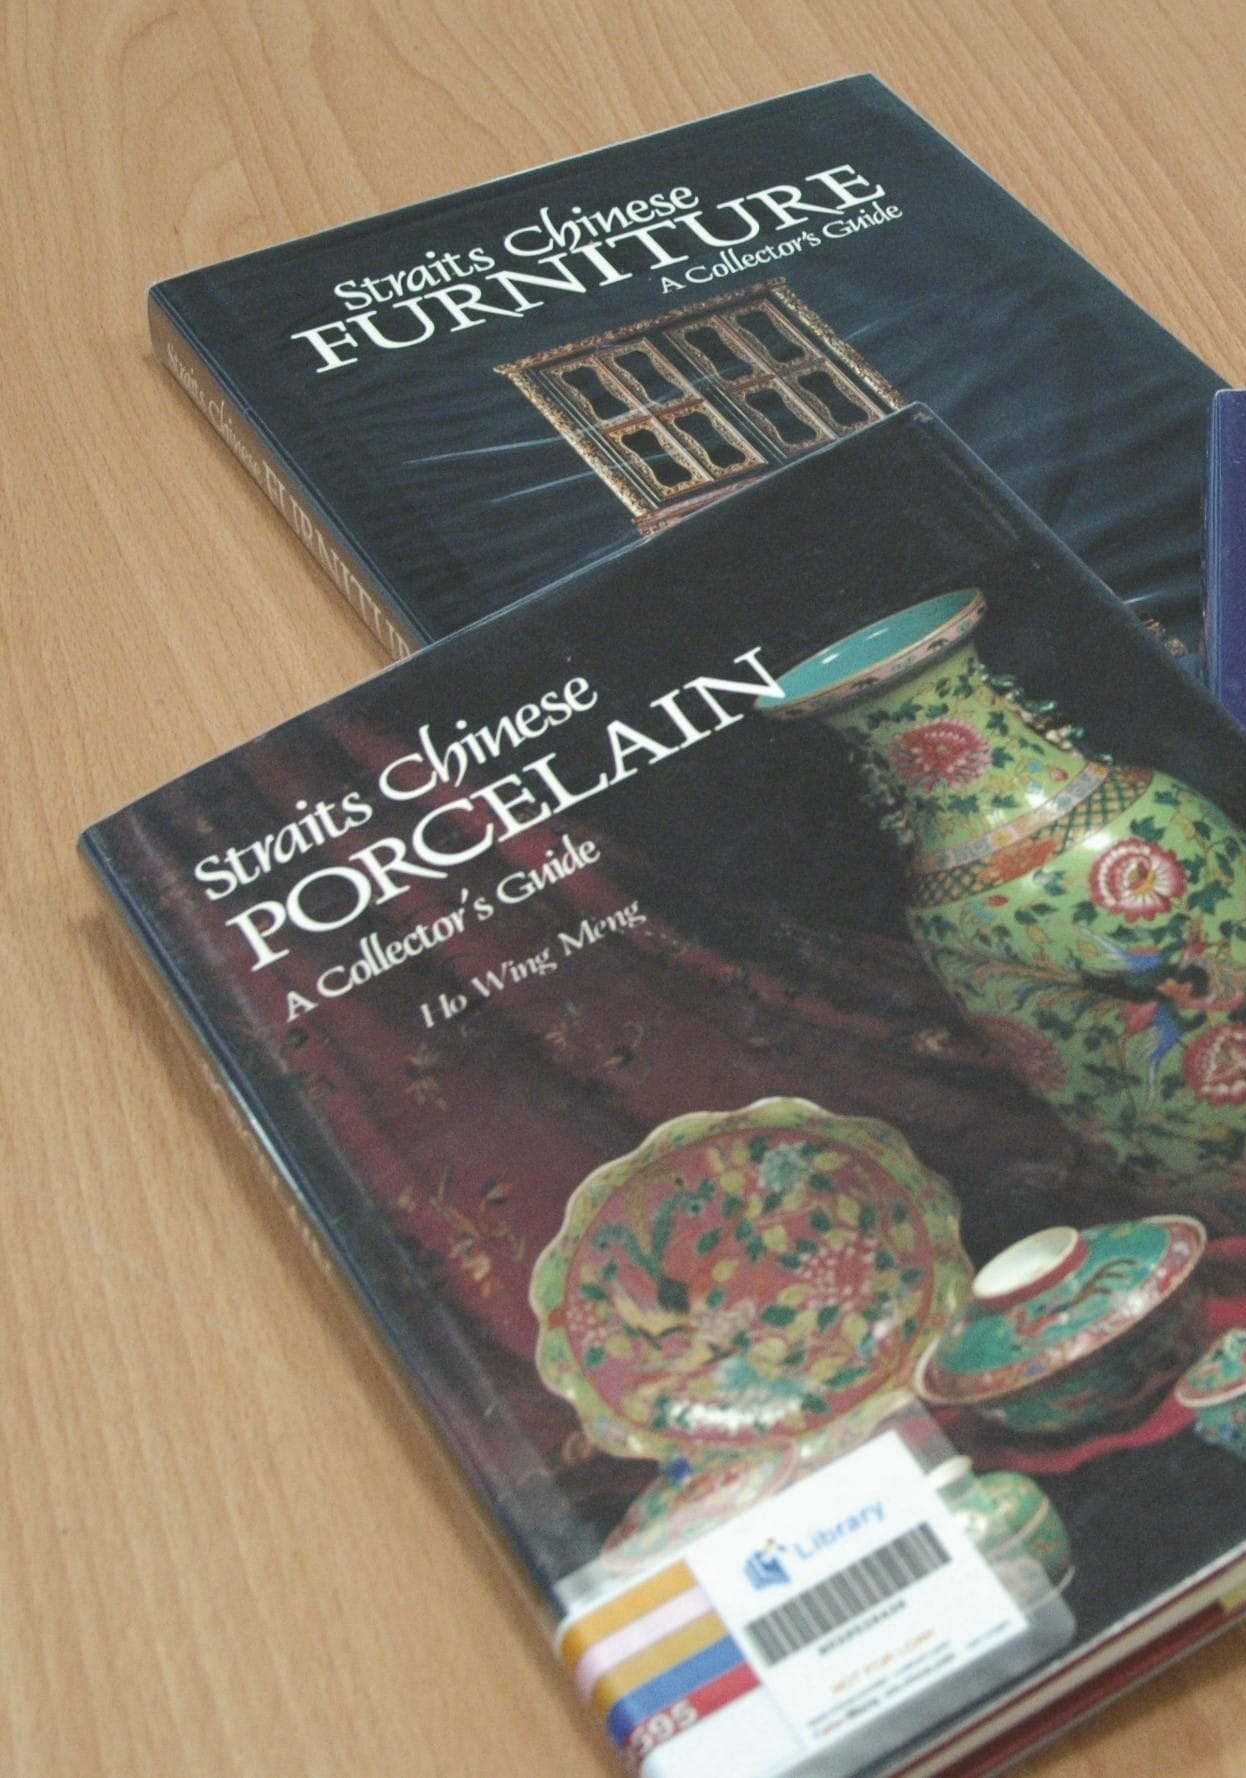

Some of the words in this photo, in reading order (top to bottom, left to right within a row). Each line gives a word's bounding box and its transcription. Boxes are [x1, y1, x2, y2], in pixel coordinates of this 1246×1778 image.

[290, 164, 886, 373] FURNITURE
[333, 245, 496, 312] Straits
[503, 185, 700, 259] Chinese
[660, 275, 687, 294] A
[684, 229, 822, 284] Collector's
[821, 199, 904, 240] Guide
[194, 790, 373, 901] Straits
[378, 676, 598, 801] Chinese
[225, 646, 787, 972] PORCELAIN
[286, 991, 317, 1022] A
[316, 888, 494, 998] Collector's
[496, 834, 602, 904] Guide
[419, 994, 468, 1029] Ho
[470, 946, 558, 998] Wing
[558, 899, 647, 958] Meng
[792, 1499, 885, 1561] Library
